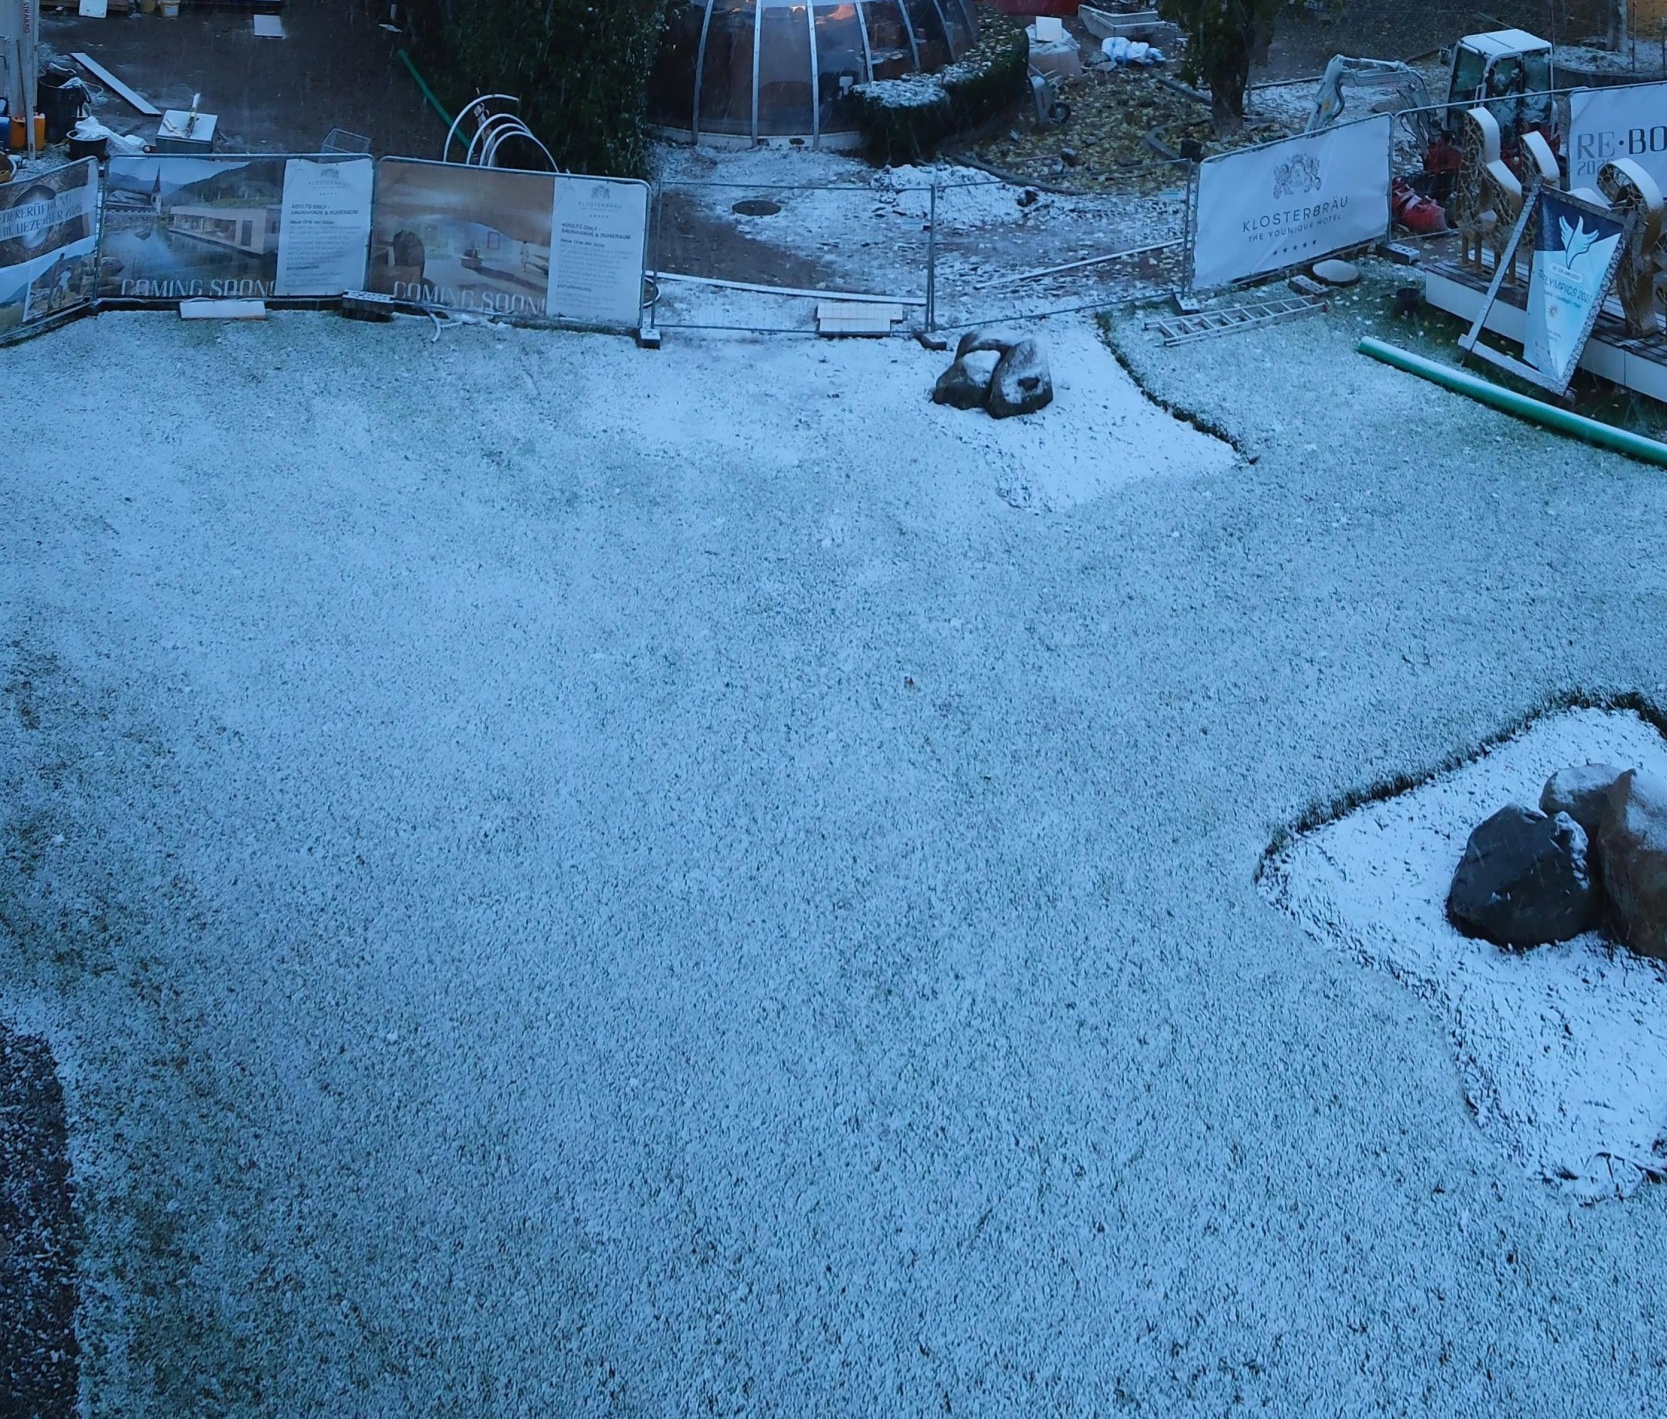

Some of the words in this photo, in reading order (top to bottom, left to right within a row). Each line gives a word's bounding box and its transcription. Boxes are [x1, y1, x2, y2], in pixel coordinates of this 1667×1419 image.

[562, 222, 583, 230] ADULTS
[1242, 195, 1349, 233] KLOSTERBRÄU
[1248, 232, 1263, 242] THE
[1269, 222, 1313, 237] YOUNIQUE
[1317, 214, 1341, 226] HOTEL
[121, 279, 203, 297] COMING
[393, 280, 475, 310] COMING
